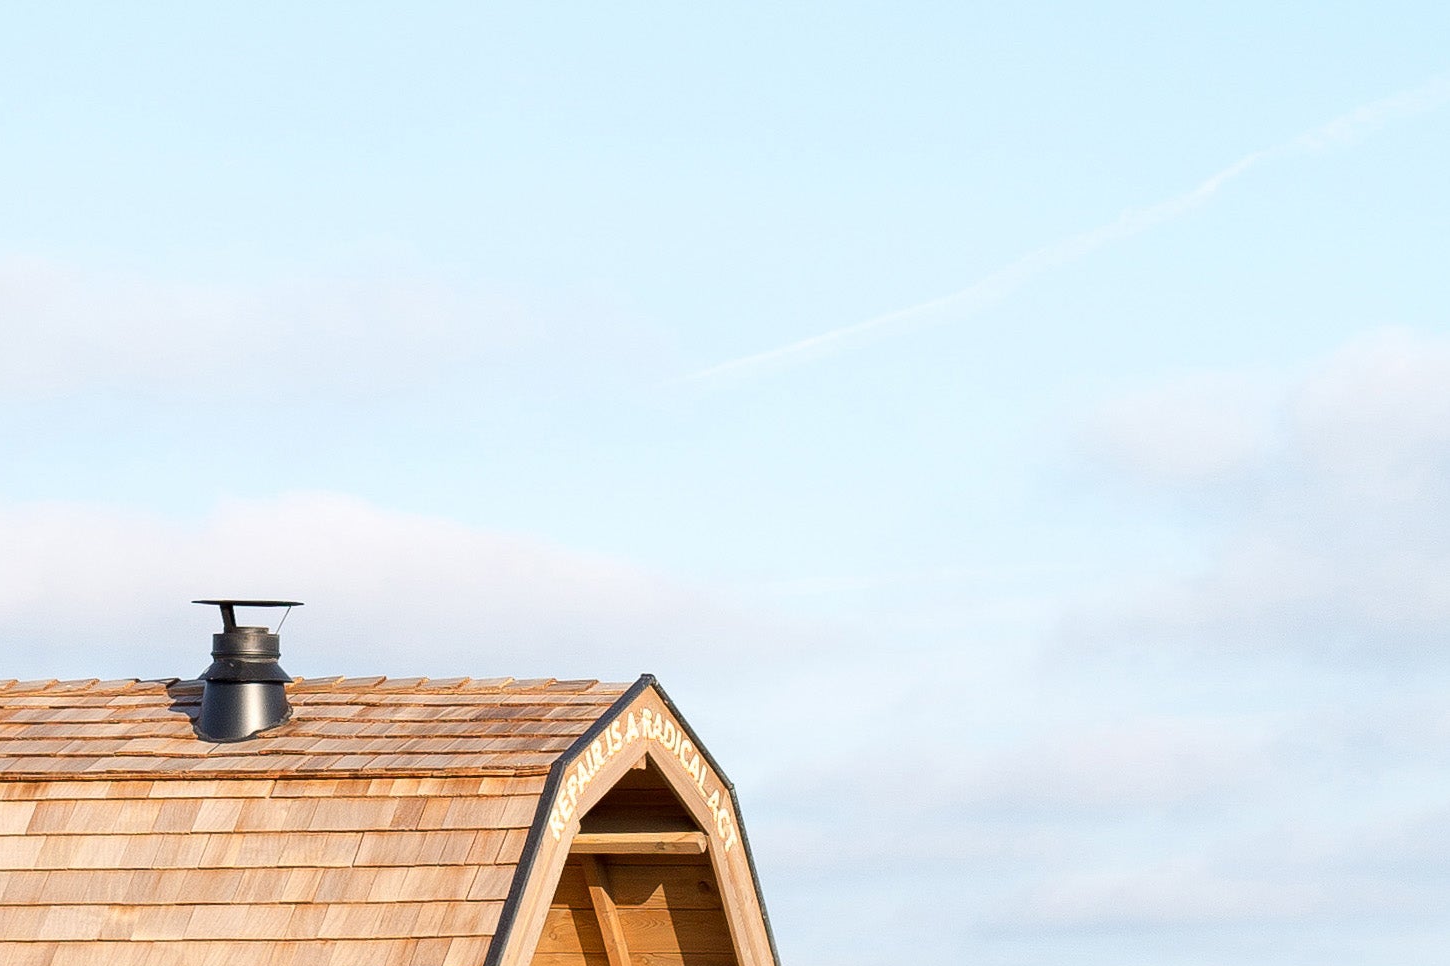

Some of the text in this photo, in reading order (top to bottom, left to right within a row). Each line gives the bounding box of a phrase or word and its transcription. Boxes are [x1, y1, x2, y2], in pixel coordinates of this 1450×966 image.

[550, 739, 606, 840] REPAIR
[605, 720, 622, 756] IS
[624, 711, 639, 743] A
[708, 789, 737, 851] ACT
